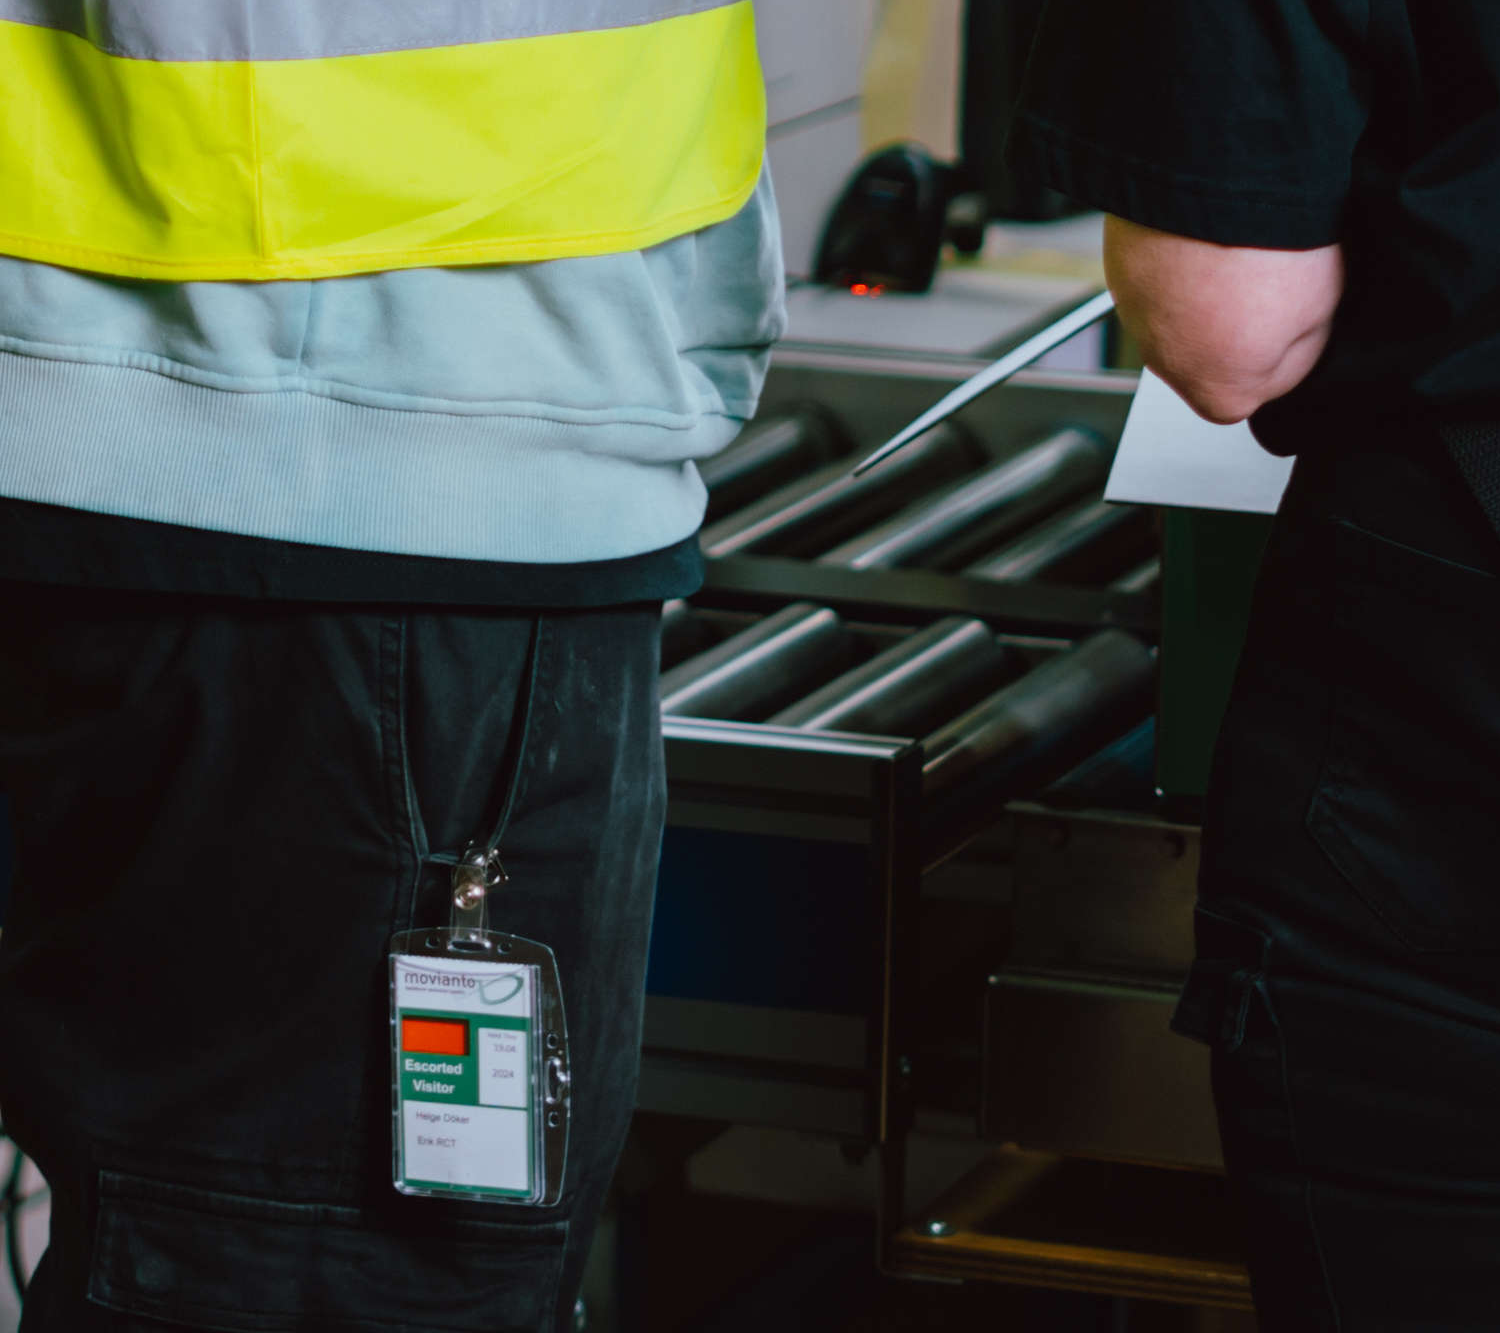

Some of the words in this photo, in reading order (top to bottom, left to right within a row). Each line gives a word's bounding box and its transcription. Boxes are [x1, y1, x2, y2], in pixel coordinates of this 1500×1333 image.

[404, 971, 476, 988] movianto
[404, 1059, 463, 1075] Escorted
[492, 1068, 515, 1079] 2024
[412, 1079, 456, 1094] Visitor
